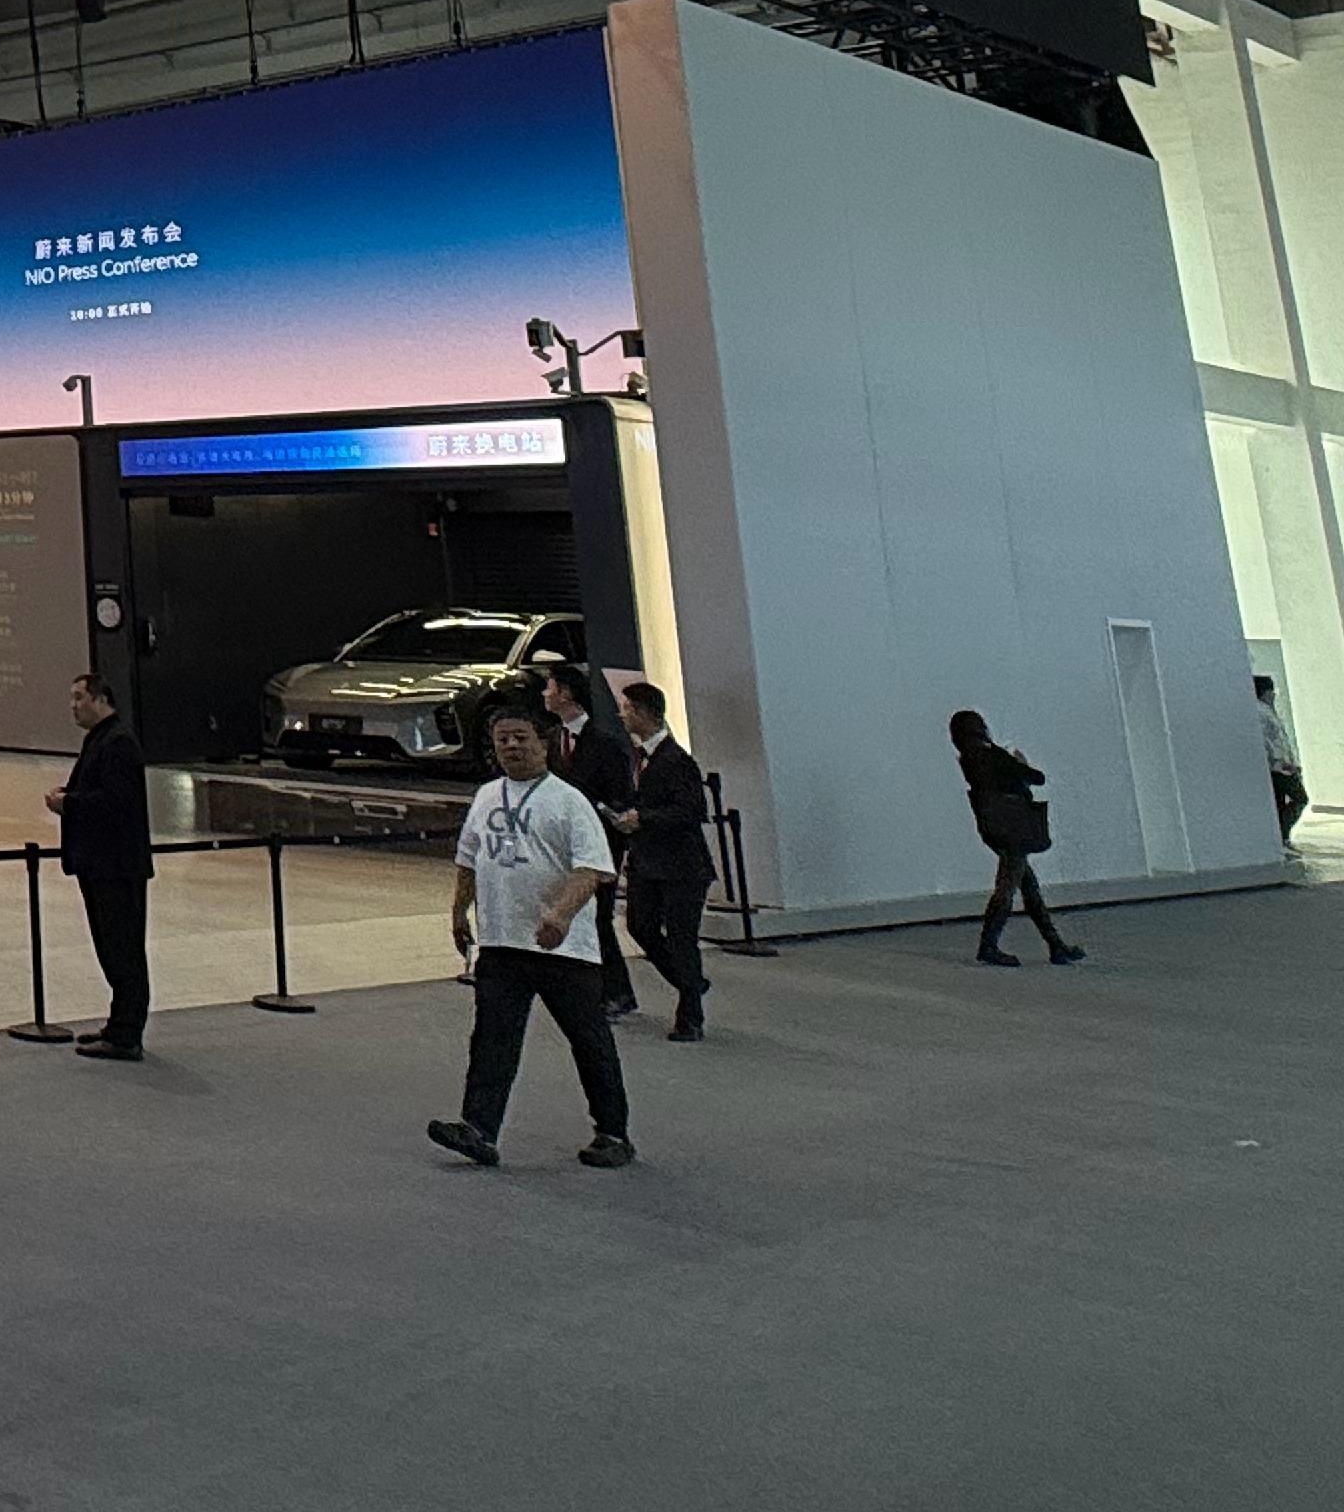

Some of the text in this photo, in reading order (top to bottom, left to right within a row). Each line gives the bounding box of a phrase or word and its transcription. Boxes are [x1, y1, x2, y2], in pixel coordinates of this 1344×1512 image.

[34, 220, 182, 260] 蔚来新闻发布会
[25, 250, 199, 287] NIO Press Conference
[427, 431, 545, 457] 蔚来换电站
